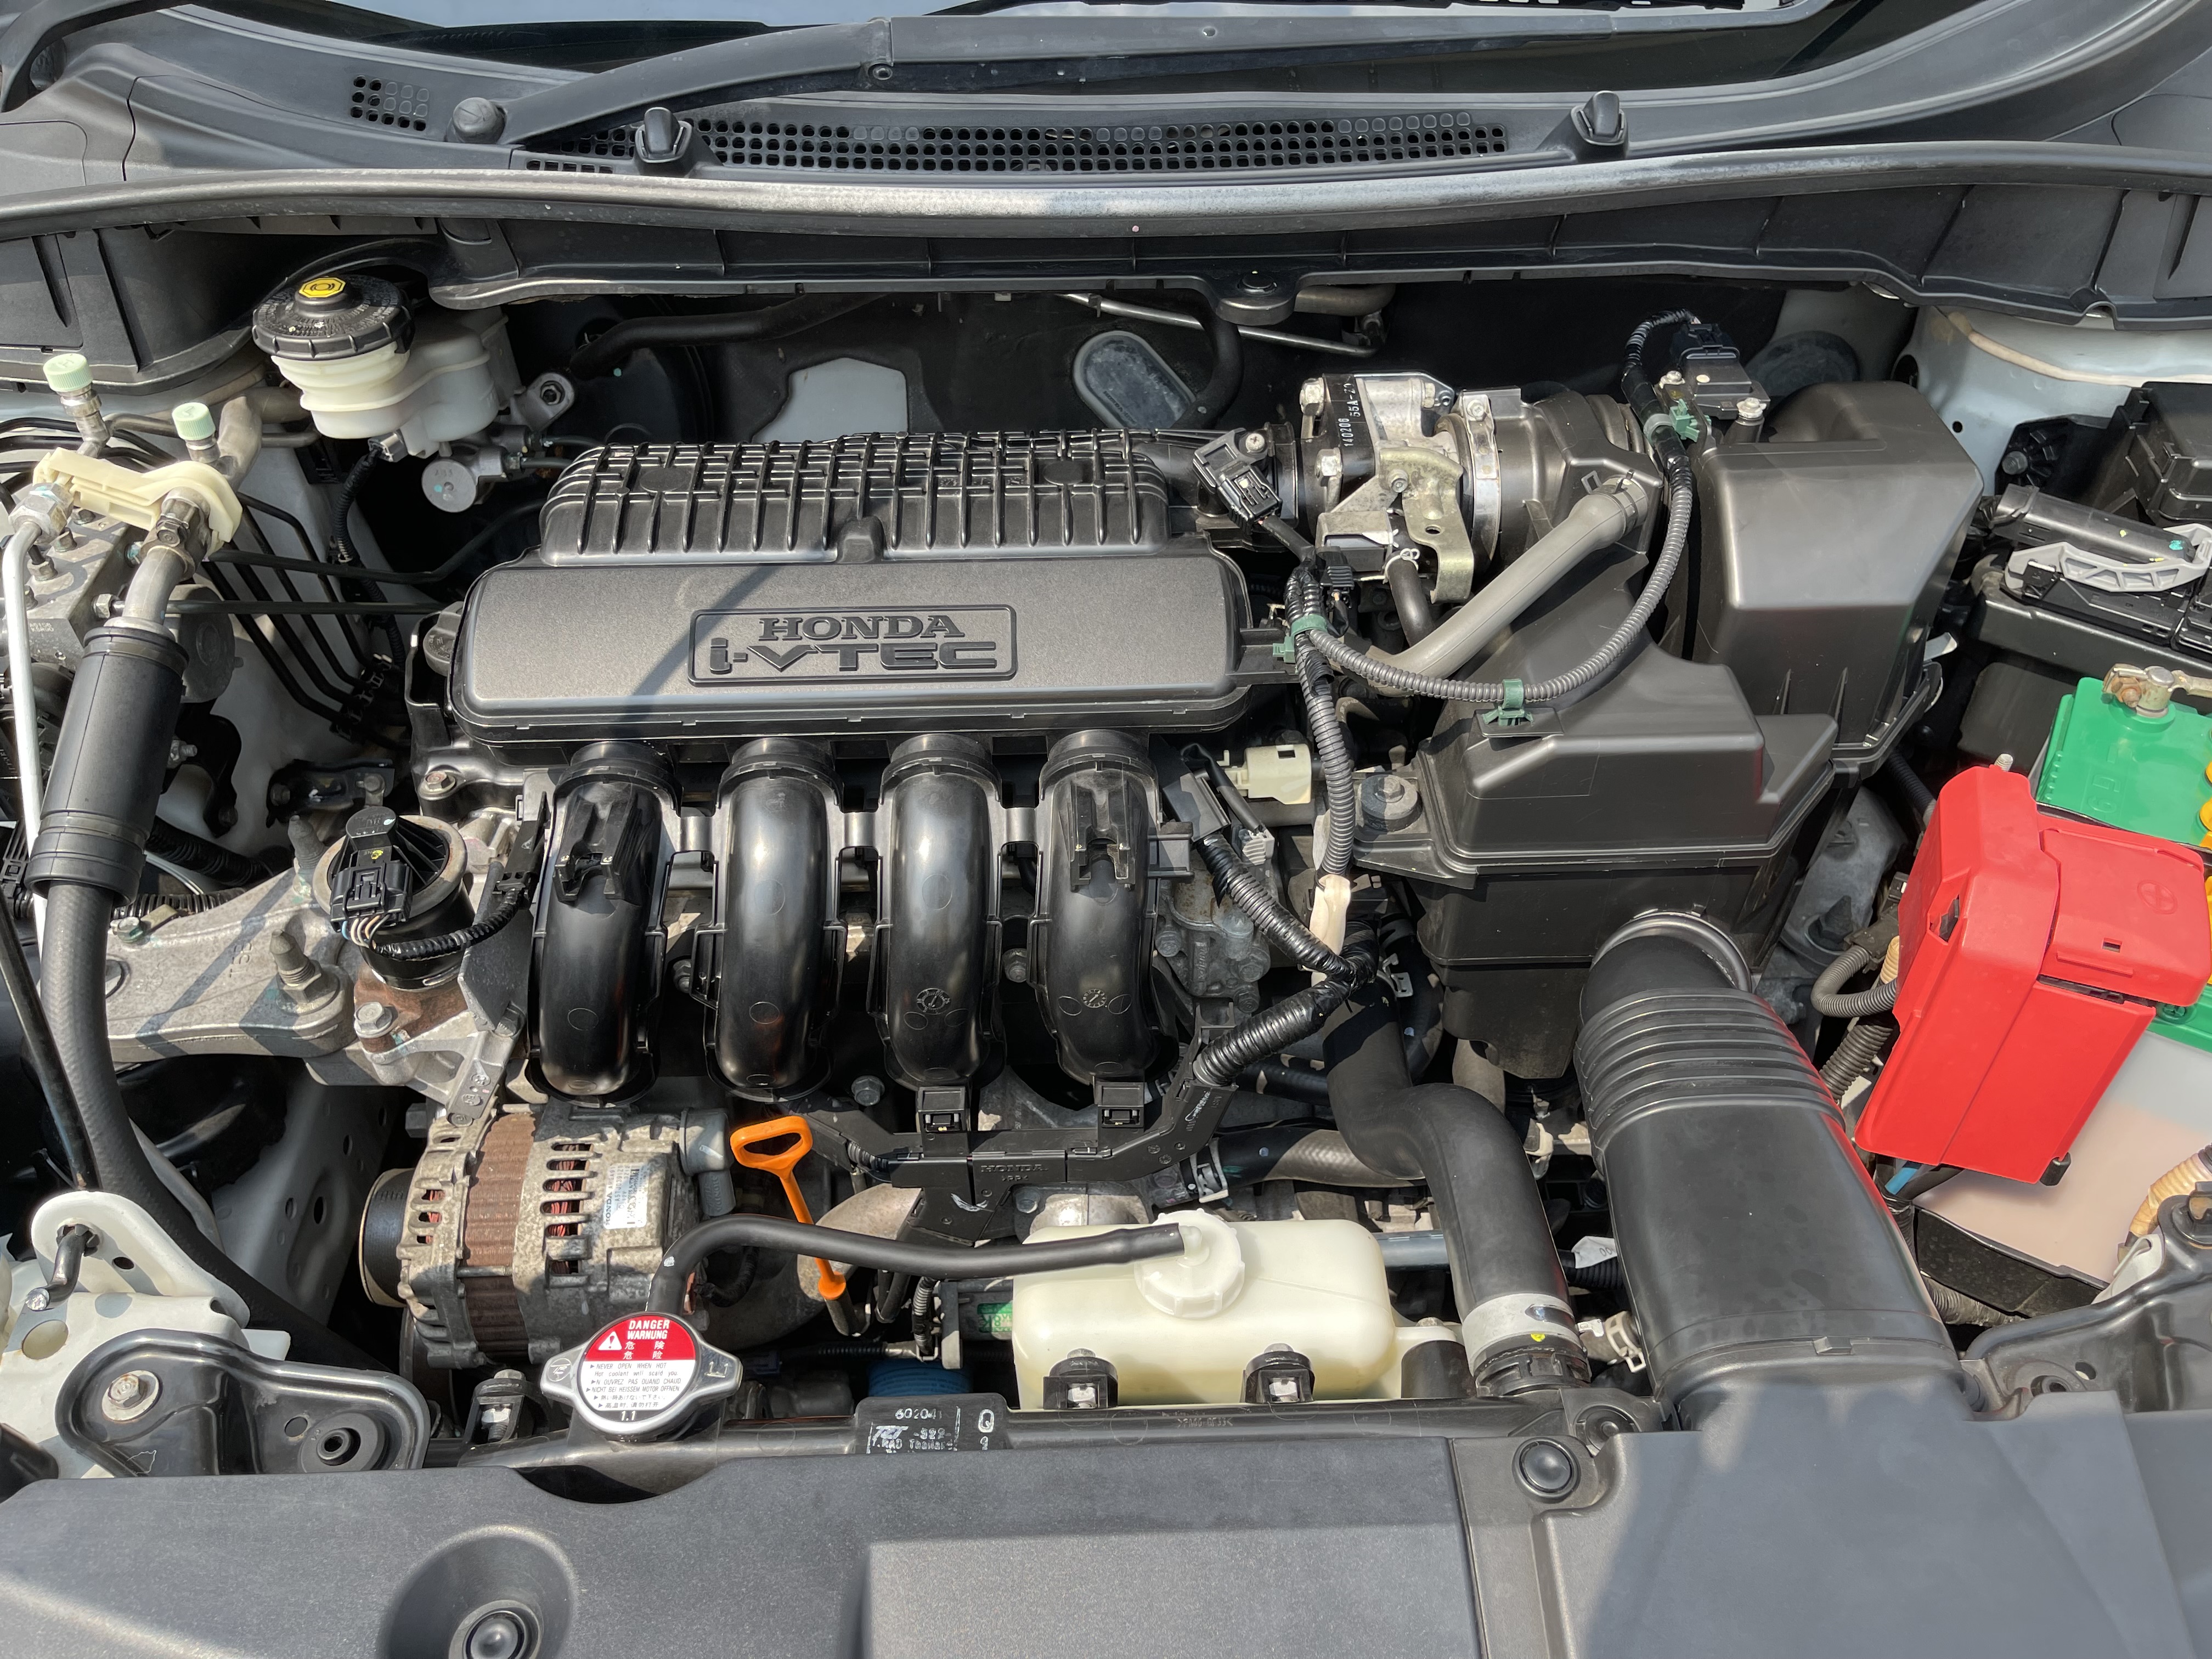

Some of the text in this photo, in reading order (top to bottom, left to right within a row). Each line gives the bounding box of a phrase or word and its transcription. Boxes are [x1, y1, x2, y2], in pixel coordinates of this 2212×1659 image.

[1338, 417, 1354, 447] 140206
[758, 615, 966, 641] HONDA
[709, 637, 997, 675] i-VTEC
[627, 1330, 668, 1340] WARNUNG
[628, 1319, 670, 1330] DANGER
[621, 1410, 636, 1421] 1.1
[978, 1409, 995, 1433] Q
